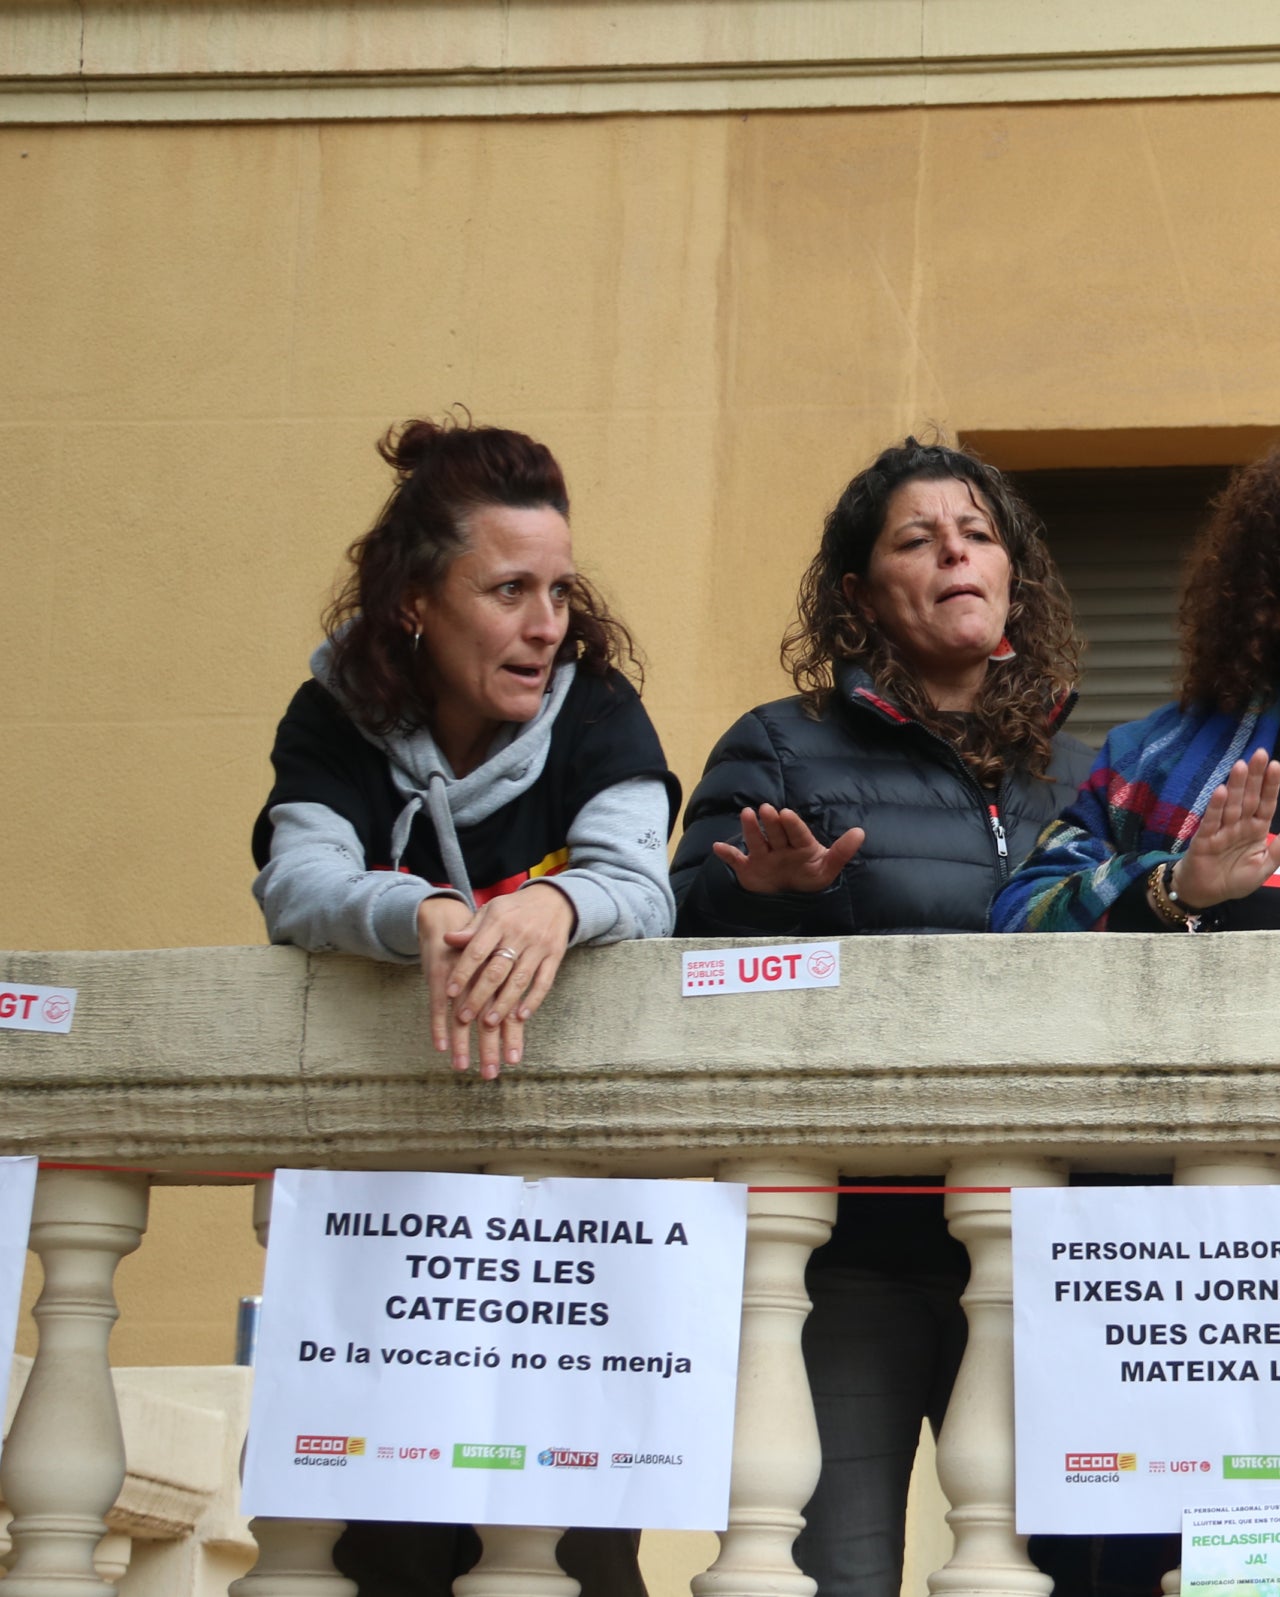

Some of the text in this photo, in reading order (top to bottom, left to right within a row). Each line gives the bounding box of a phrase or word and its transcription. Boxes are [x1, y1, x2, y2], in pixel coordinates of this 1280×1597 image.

[687, 960, 724, 969] SERVEIS
[739, 954, 802, 983] UGT
[687, 970, 724, 978] PÚBLICS
[325, 1212, 688, 1246] MILLORA SALARIAL A
[1052, 1241, 1190, 1261] PERSONAL
[405, 1254, 595, 1285] TOTES LES
[1055, 1280, 1165, 1302] FIXESA
[1175, 1280, 1183, 1301] I
[385, 1295, 609, 1327] CATEGORIES
[1106, 1323, 1188, 1346] DUES
[299, 1340, 691, 1379] De la vocació no es menja
[1121, 1360, 1260, 1382] MATEIXA
[299, 1439, 344, 1451] CCOO
[399, 1448, 427, 1459] UGT
[552, 1452, 597, 1467] JUNTS
[612, 1453, 683, 1465] CGT LABORALS
[294, 1455, 347, 1466] educació
[1069, 1457, 1114, 1468] CCOO
[1170, 1461, 1197, 1472] UGT
[1065, 1472, 1119, 1483] educació
[1245, 1554, 1267, 1565] JA!
[1191, 1578, 1235, 1586] MODIFICACIÓ
